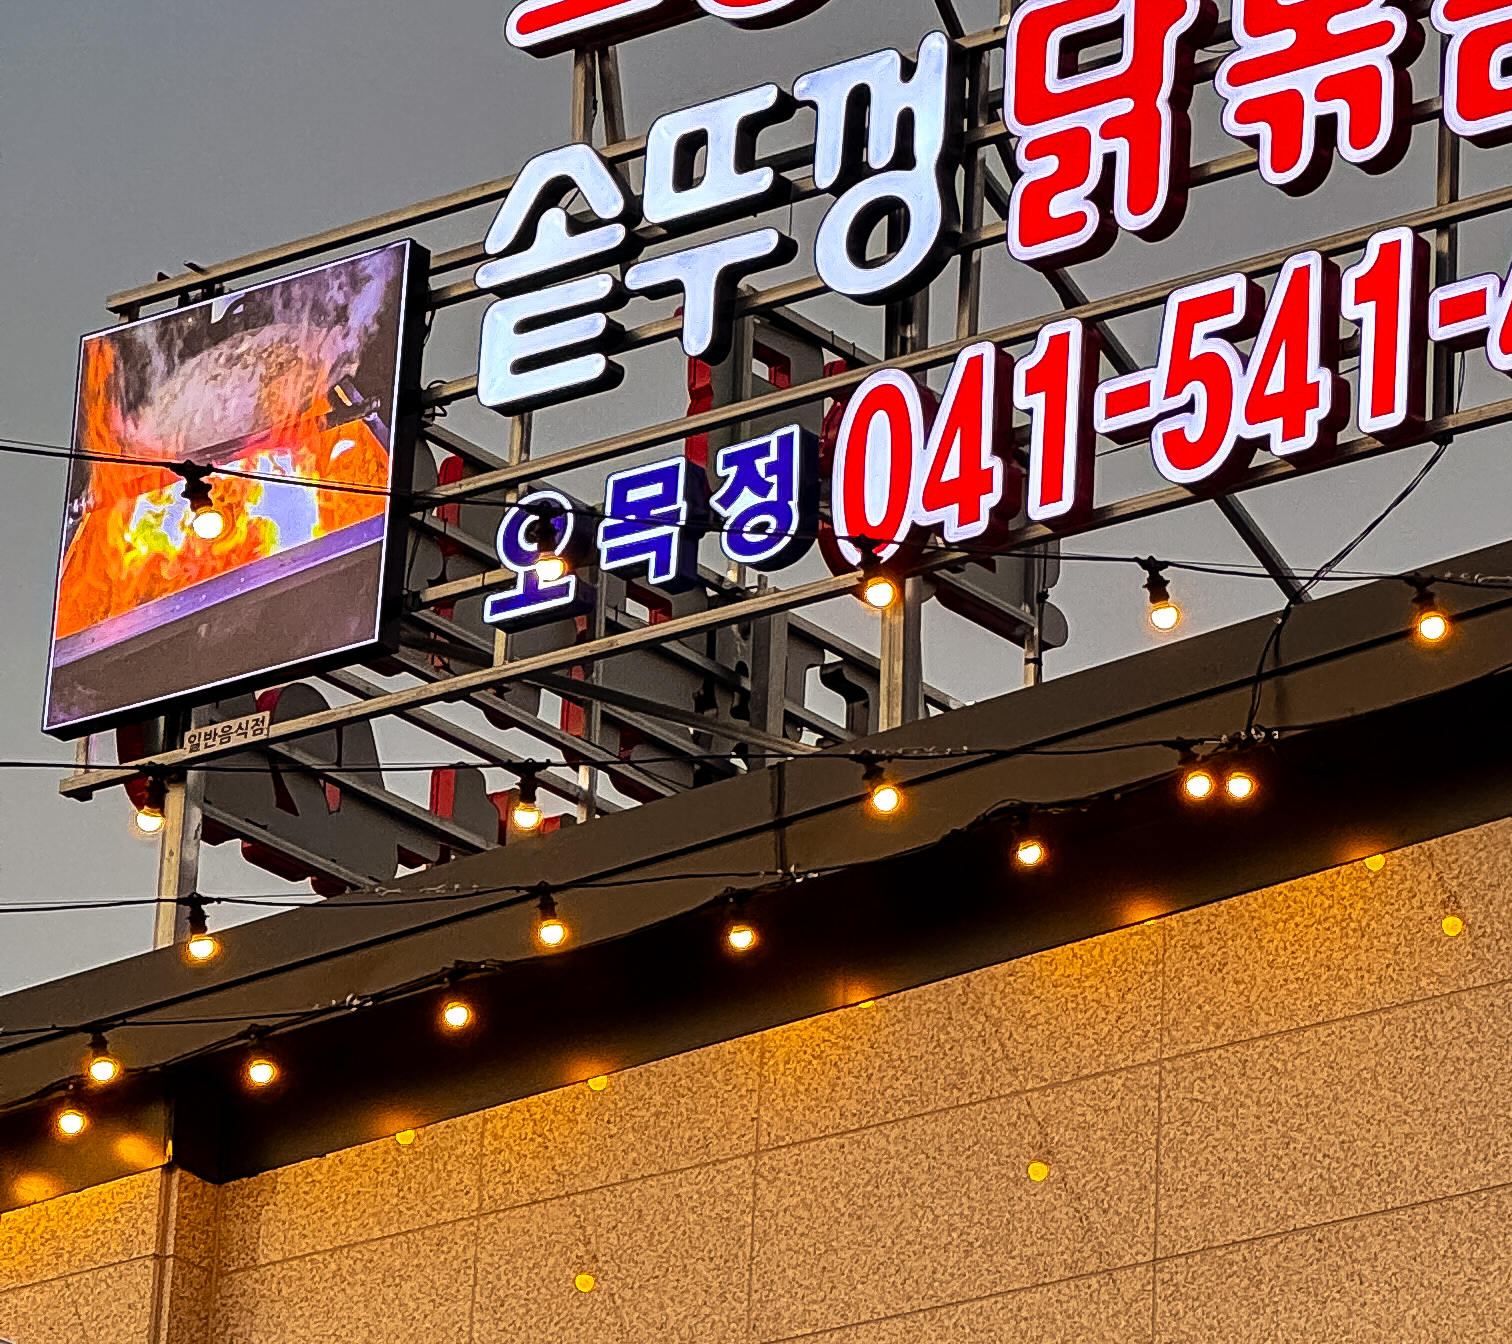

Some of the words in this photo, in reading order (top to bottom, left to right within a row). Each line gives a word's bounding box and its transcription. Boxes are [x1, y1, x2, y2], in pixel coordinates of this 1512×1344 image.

[475, 30, 949, 411] 솥뚜껑
[483, 424, 800, 625] 오목정
[187, 715, 266, 754] 일반음식점
